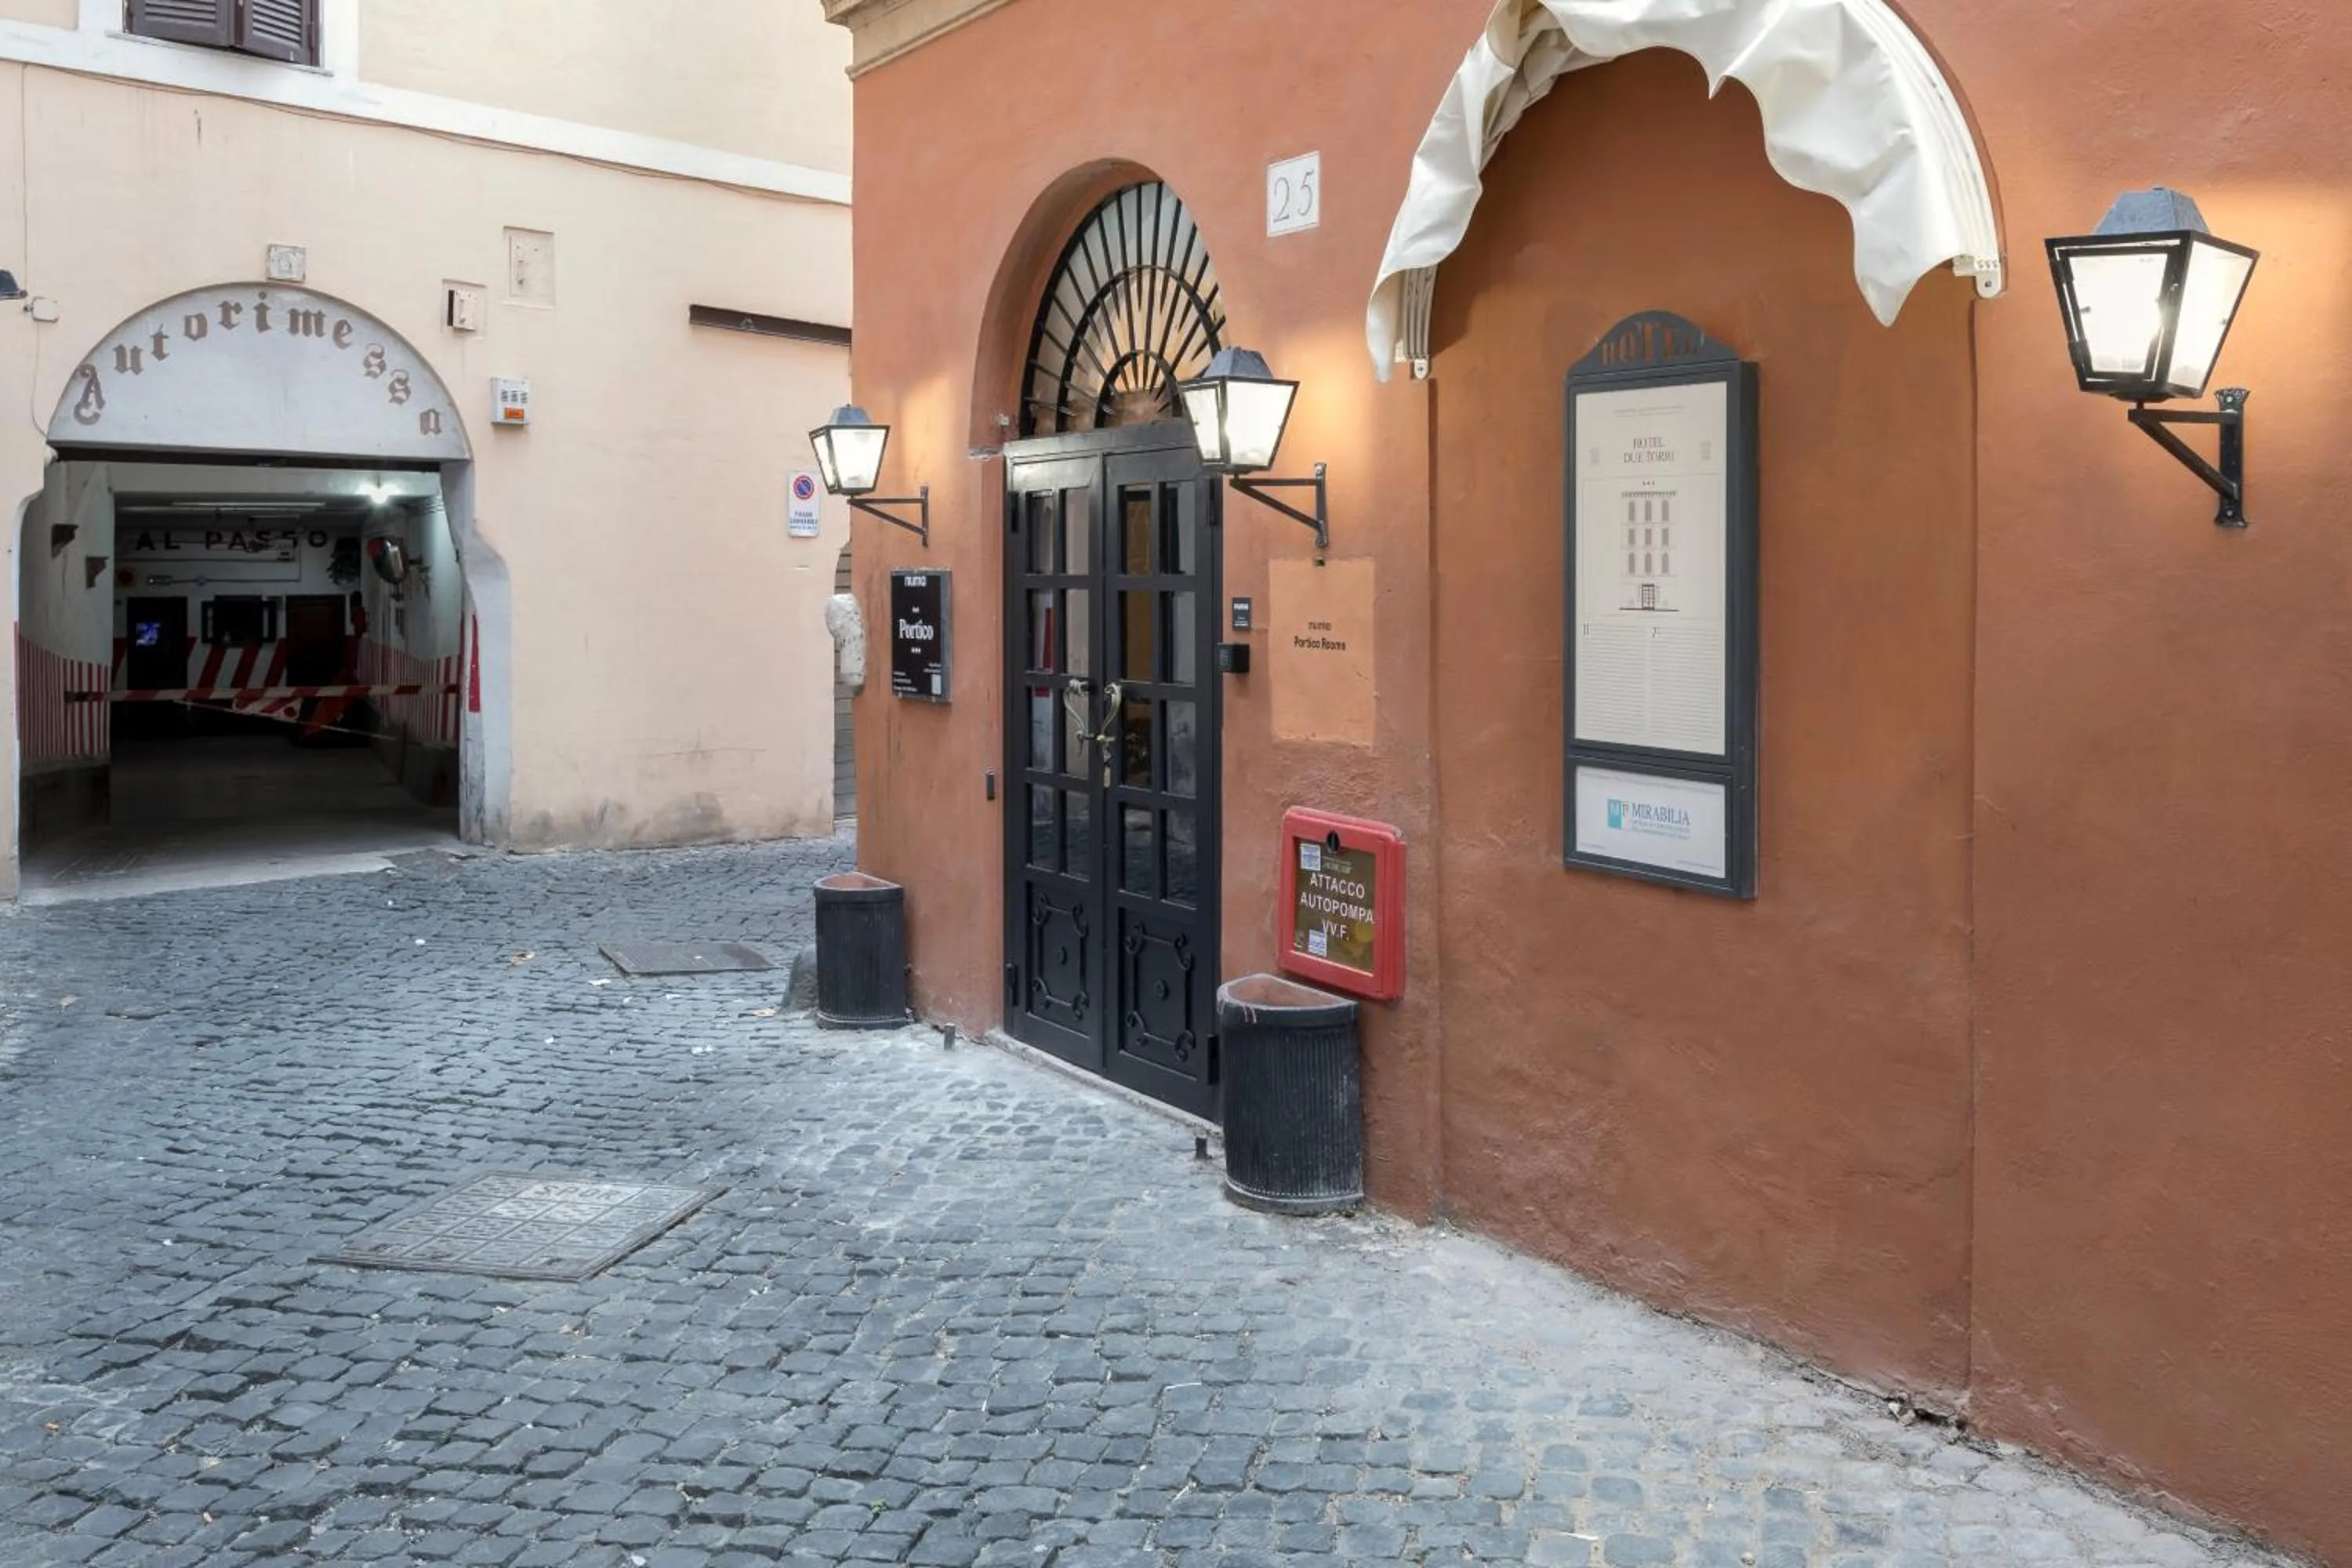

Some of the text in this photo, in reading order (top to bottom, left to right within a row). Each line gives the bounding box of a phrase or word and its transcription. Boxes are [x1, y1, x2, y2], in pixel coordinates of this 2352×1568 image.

[1272, 169, 1315, 223] 25
[74, 291, 441, 436] Autorimessa
[136, 531, 181, 551] AL
[904, 575, 927, 587] numa
[898, 619, 934, 641] Portico
[1632, 802, 1690, 826] MIRABILIA
[1310, 872, 1366, 899] ATTACCO
[1300, 891, 1375, 925] AUTOPOMPA
